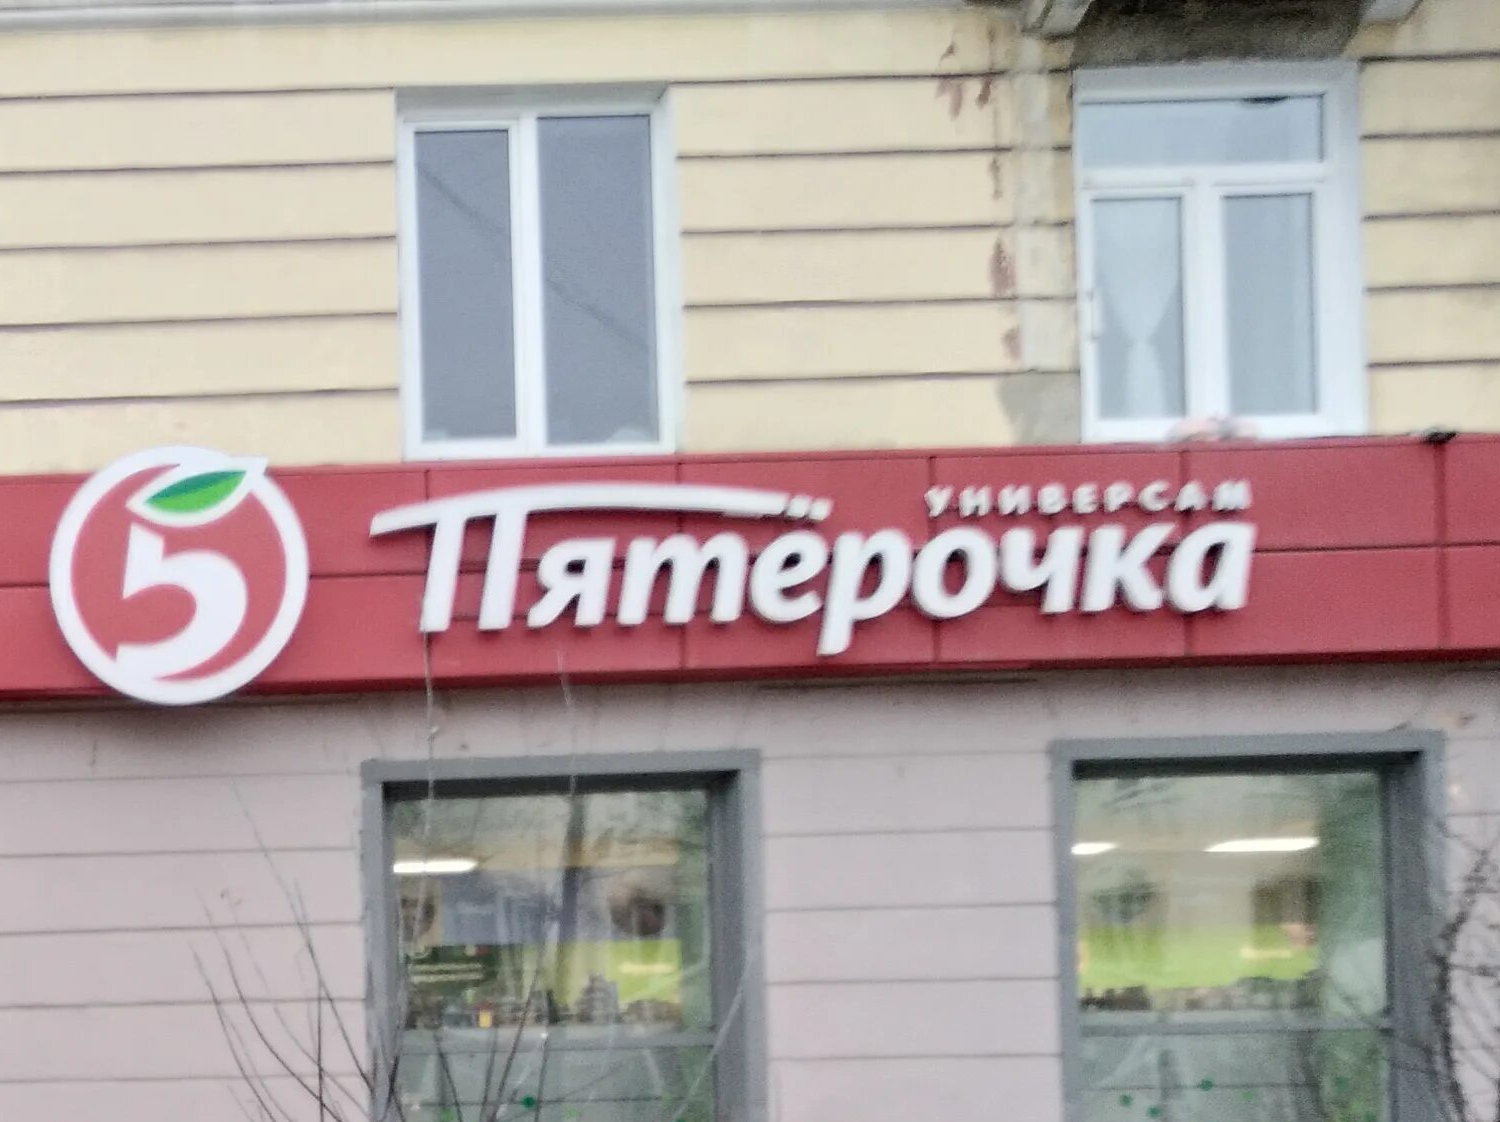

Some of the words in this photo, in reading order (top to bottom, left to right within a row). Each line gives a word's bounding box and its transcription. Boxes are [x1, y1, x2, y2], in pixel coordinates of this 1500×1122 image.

[368, 480, 1257, 656] Пятёрочка
[923, 479, 1254, 518] УНИВЕРСАМ
[116, 522, 248, 681] 5
